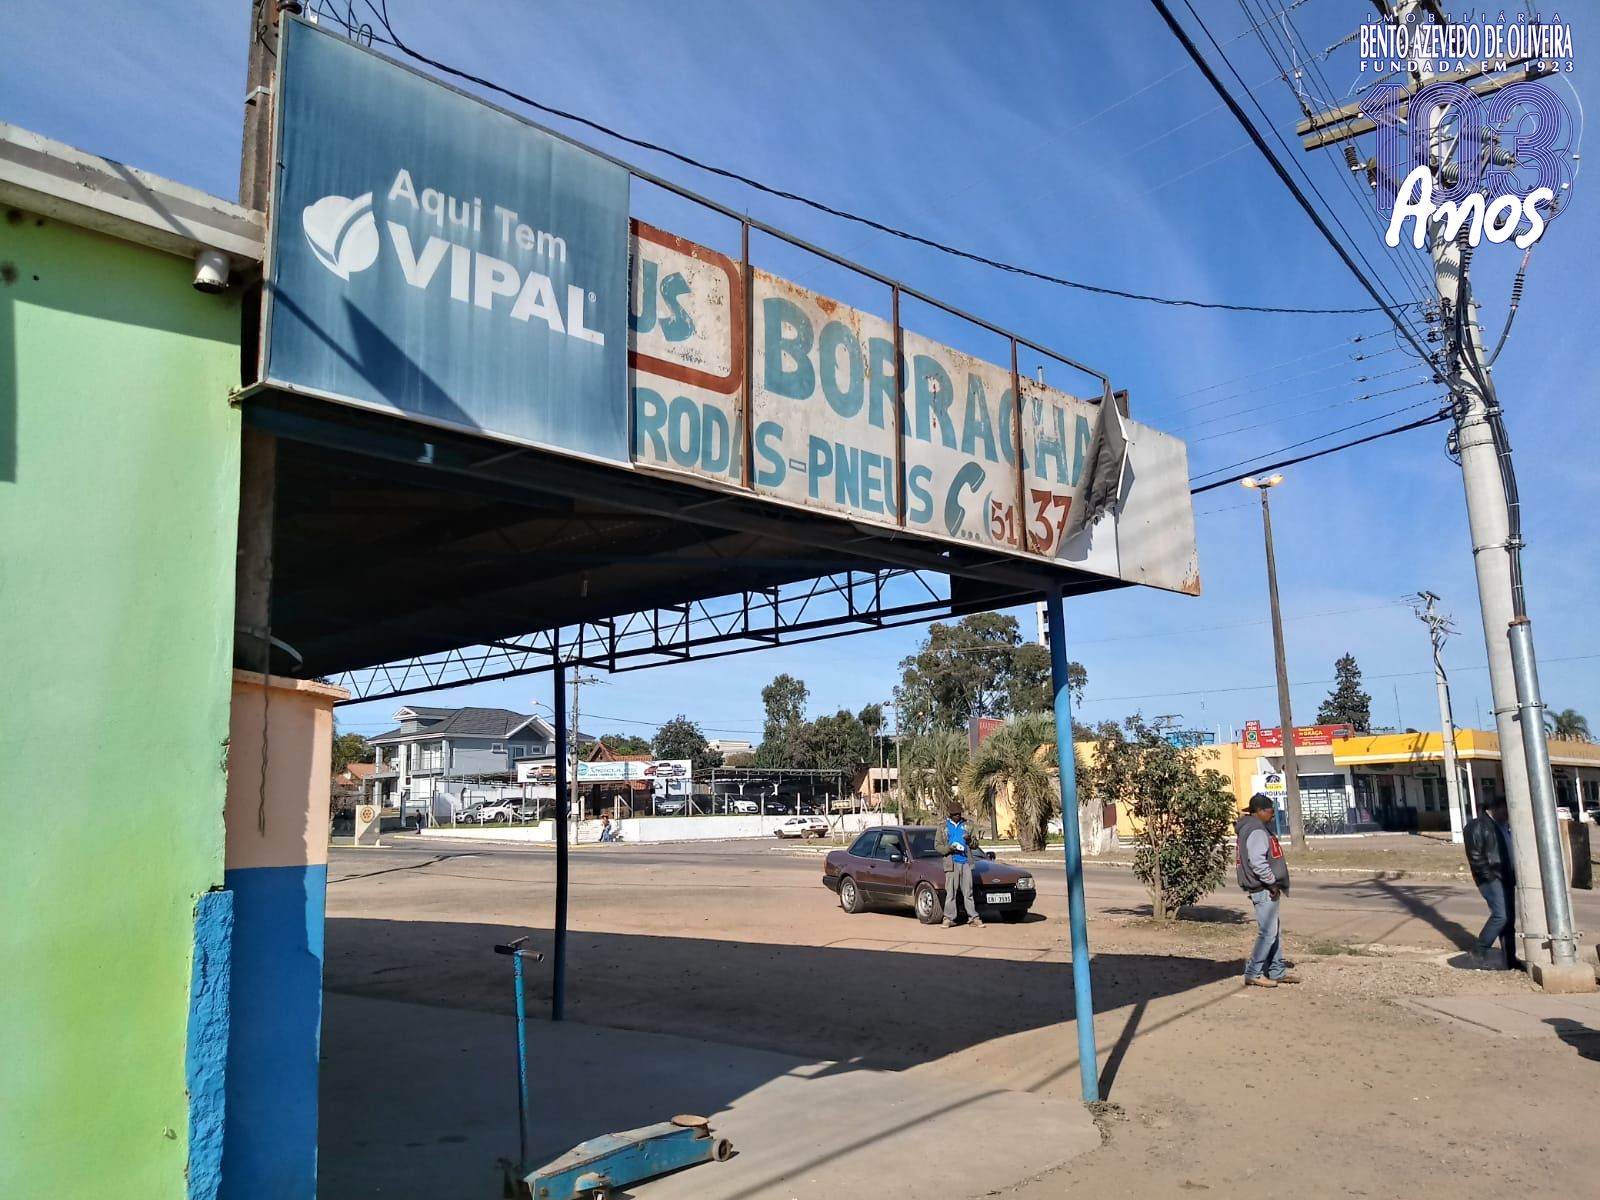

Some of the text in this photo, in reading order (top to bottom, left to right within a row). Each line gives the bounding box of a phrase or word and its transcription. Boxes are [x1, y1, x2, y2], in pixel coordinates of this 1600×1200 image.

[387, 168, 567, 263] Aqui Tem
[386, 220, 605, 346] VIPAL
